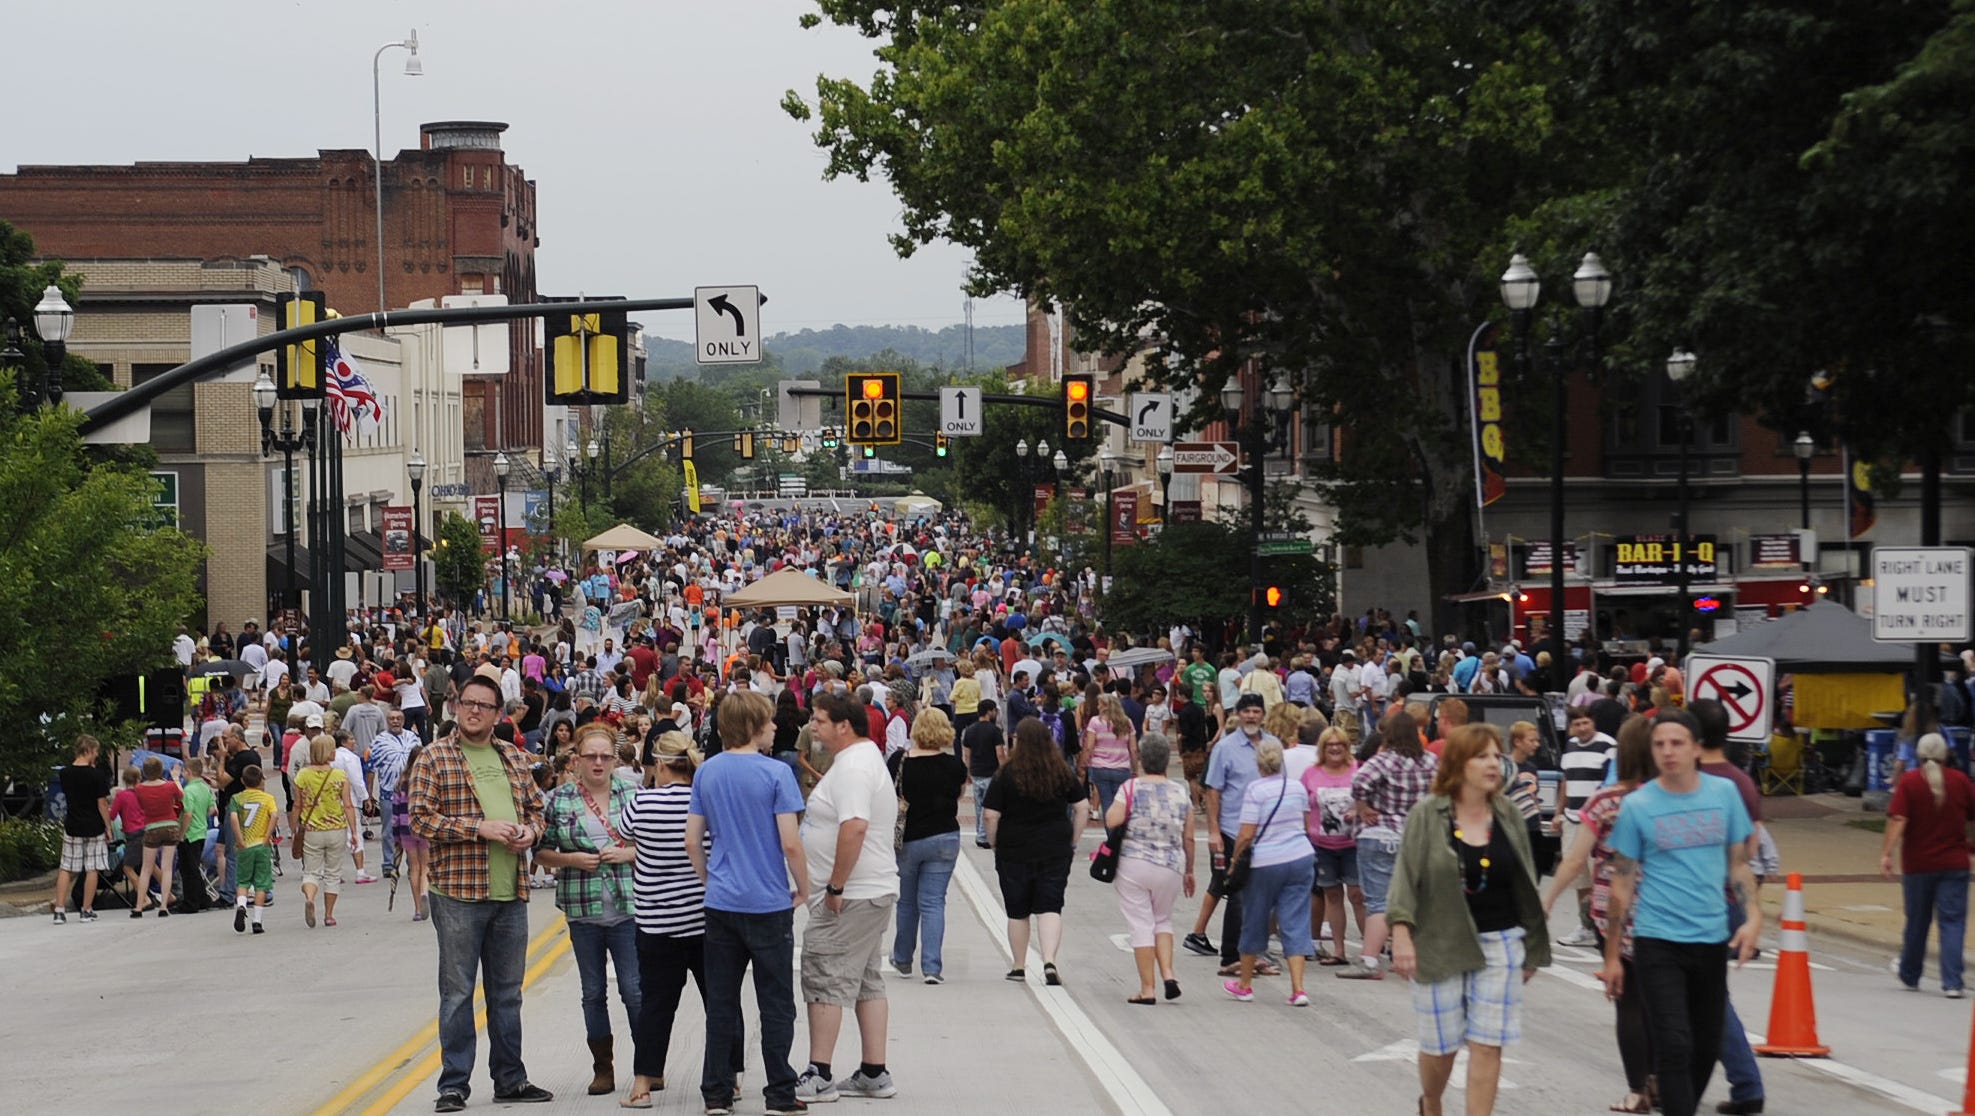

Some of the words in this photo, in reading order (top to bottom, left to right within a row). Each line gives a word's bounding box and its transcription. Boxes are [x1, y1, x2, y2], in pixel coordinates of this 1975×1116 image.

[706, 341, 751, 356] ONLY
[1476, 351, 1505, 463] BBQ
[947, 422, 976, 431] ONLY
[1136, 428, 1165, 438] ONLY
[1176, 453, 1231, 463] FAIRGROUND
[1881, 561, 1920, 574] RIGHT
[1926, 561, 1963, 574] LANE
[1896, 586, 1947, 602] MUST
[1880, 614, 1917, 628] TURN
[1922, 614, 1964, 628] RIGHT
[243, 802, 261, 828] 7
